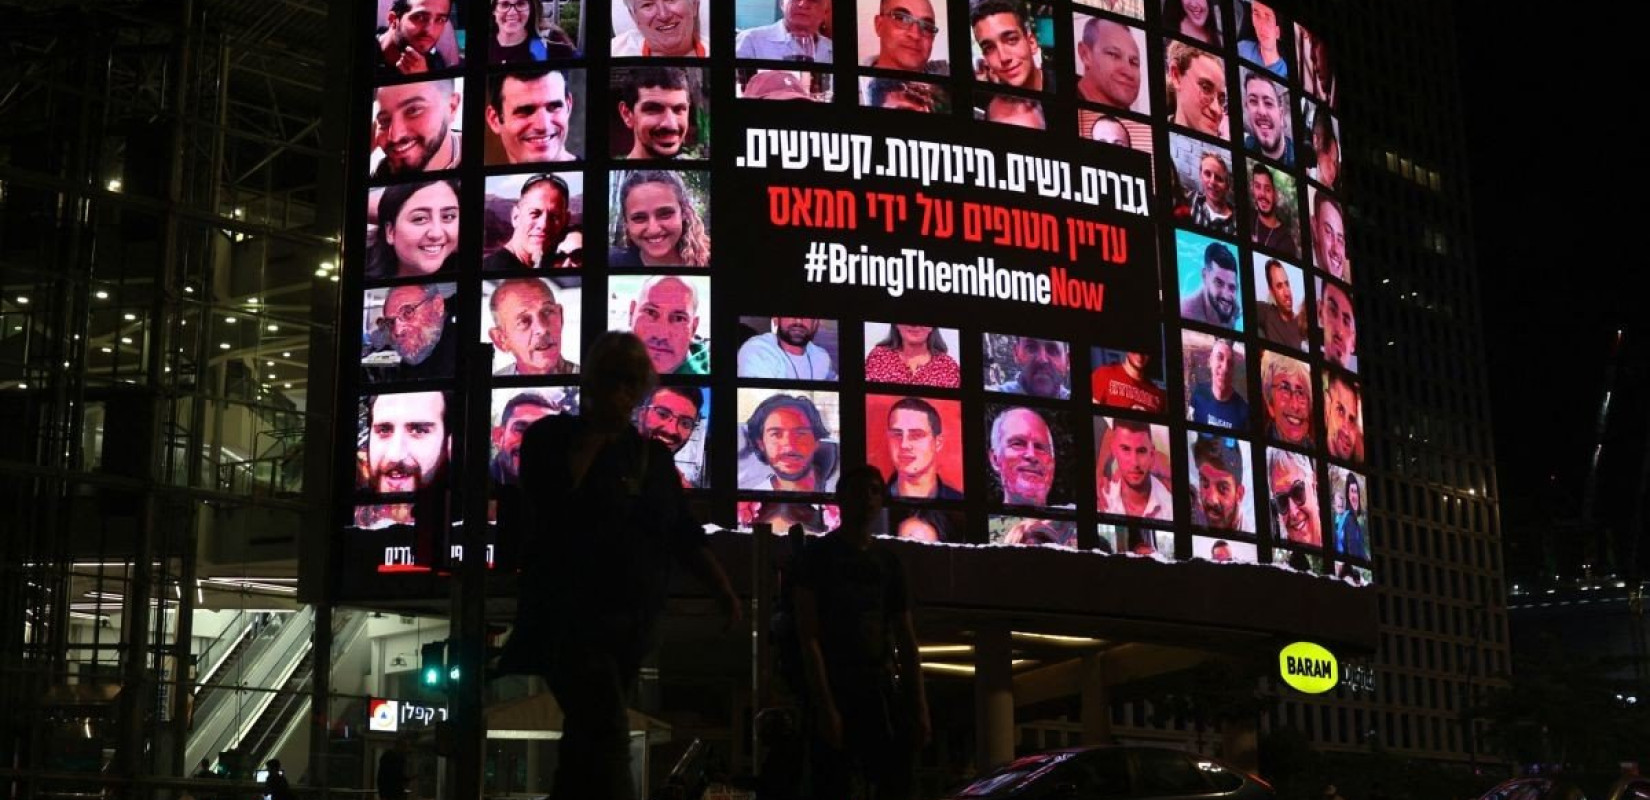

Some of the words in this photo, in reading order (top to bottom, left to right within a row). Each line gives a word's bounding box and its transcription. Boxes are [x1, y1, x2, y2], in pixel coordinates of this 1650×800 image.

[768, 186, 857, 230] חמאס
[866, 192, 907, 233] ידי
[916, 192, 954, 239] על
[963, 202, 1060, 253] חטופים
[1067, 217, 1128, 264] עדיין
[804, 242, 1105, 312] #BringThemHomeNow
[1286, 655, 1332, 679] BARAM
[400, 701, 435, 726] קפלן
